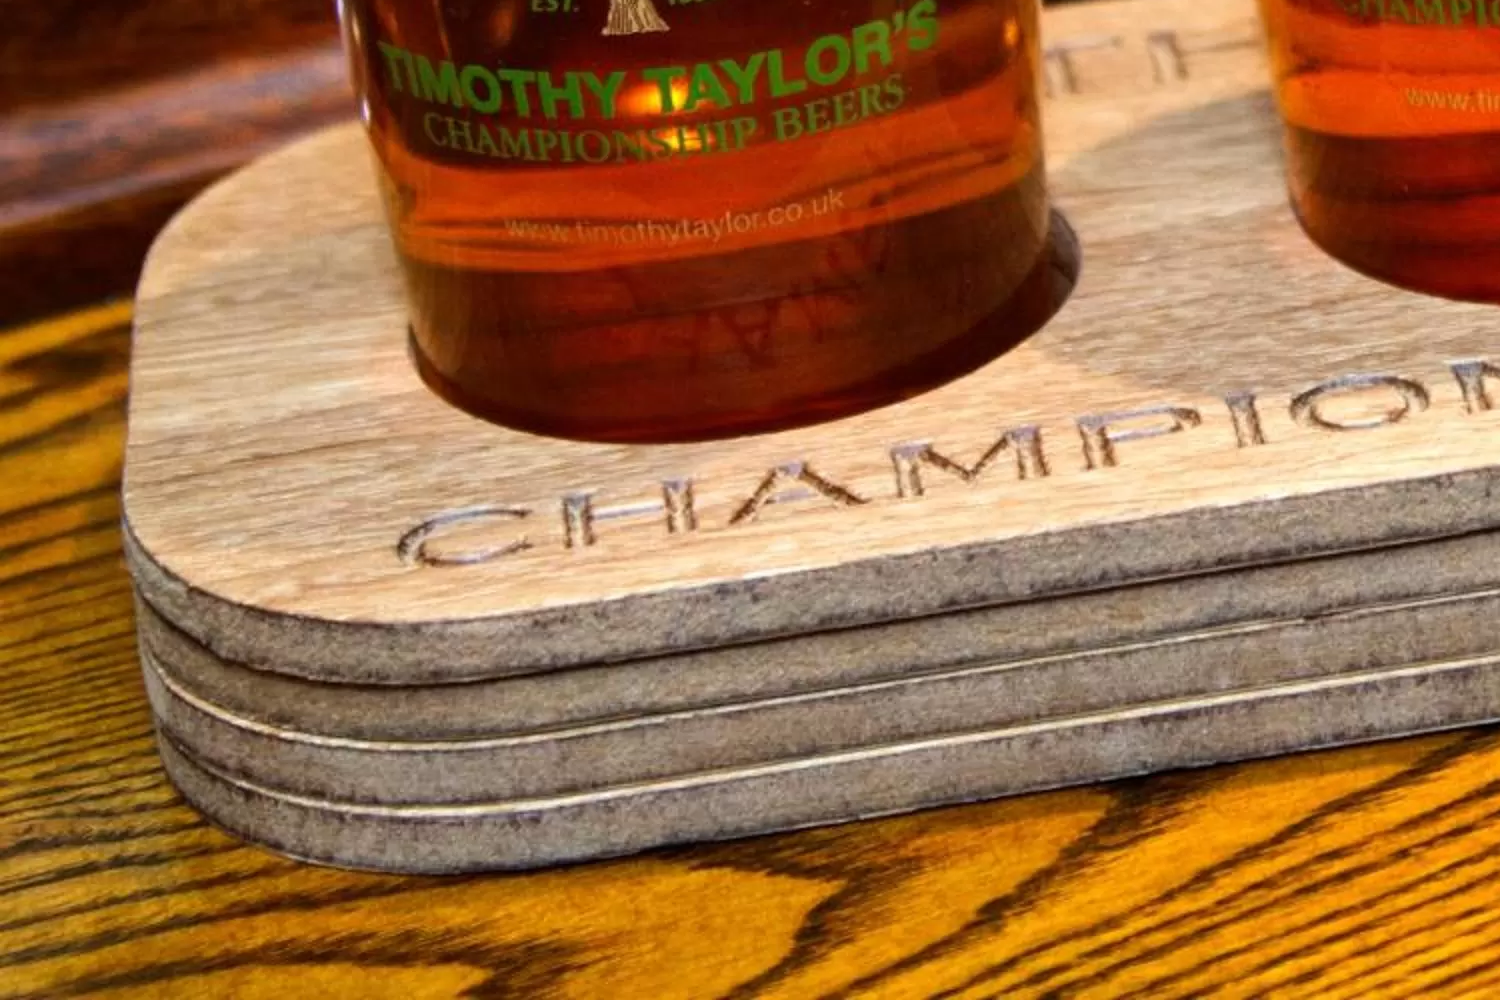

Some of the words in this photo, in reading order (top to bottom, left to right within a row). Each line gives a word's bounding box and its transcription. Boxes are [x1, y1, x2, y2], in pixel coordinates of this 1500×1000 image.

[377, 38, 629, 122] TIMOTHY
[422, 110, 758, 164] CHAMPIONSHIP
[772, 72, 906, 142] BEERS
[503, 188, 846, 247] www.timothytaylor.co.uk
